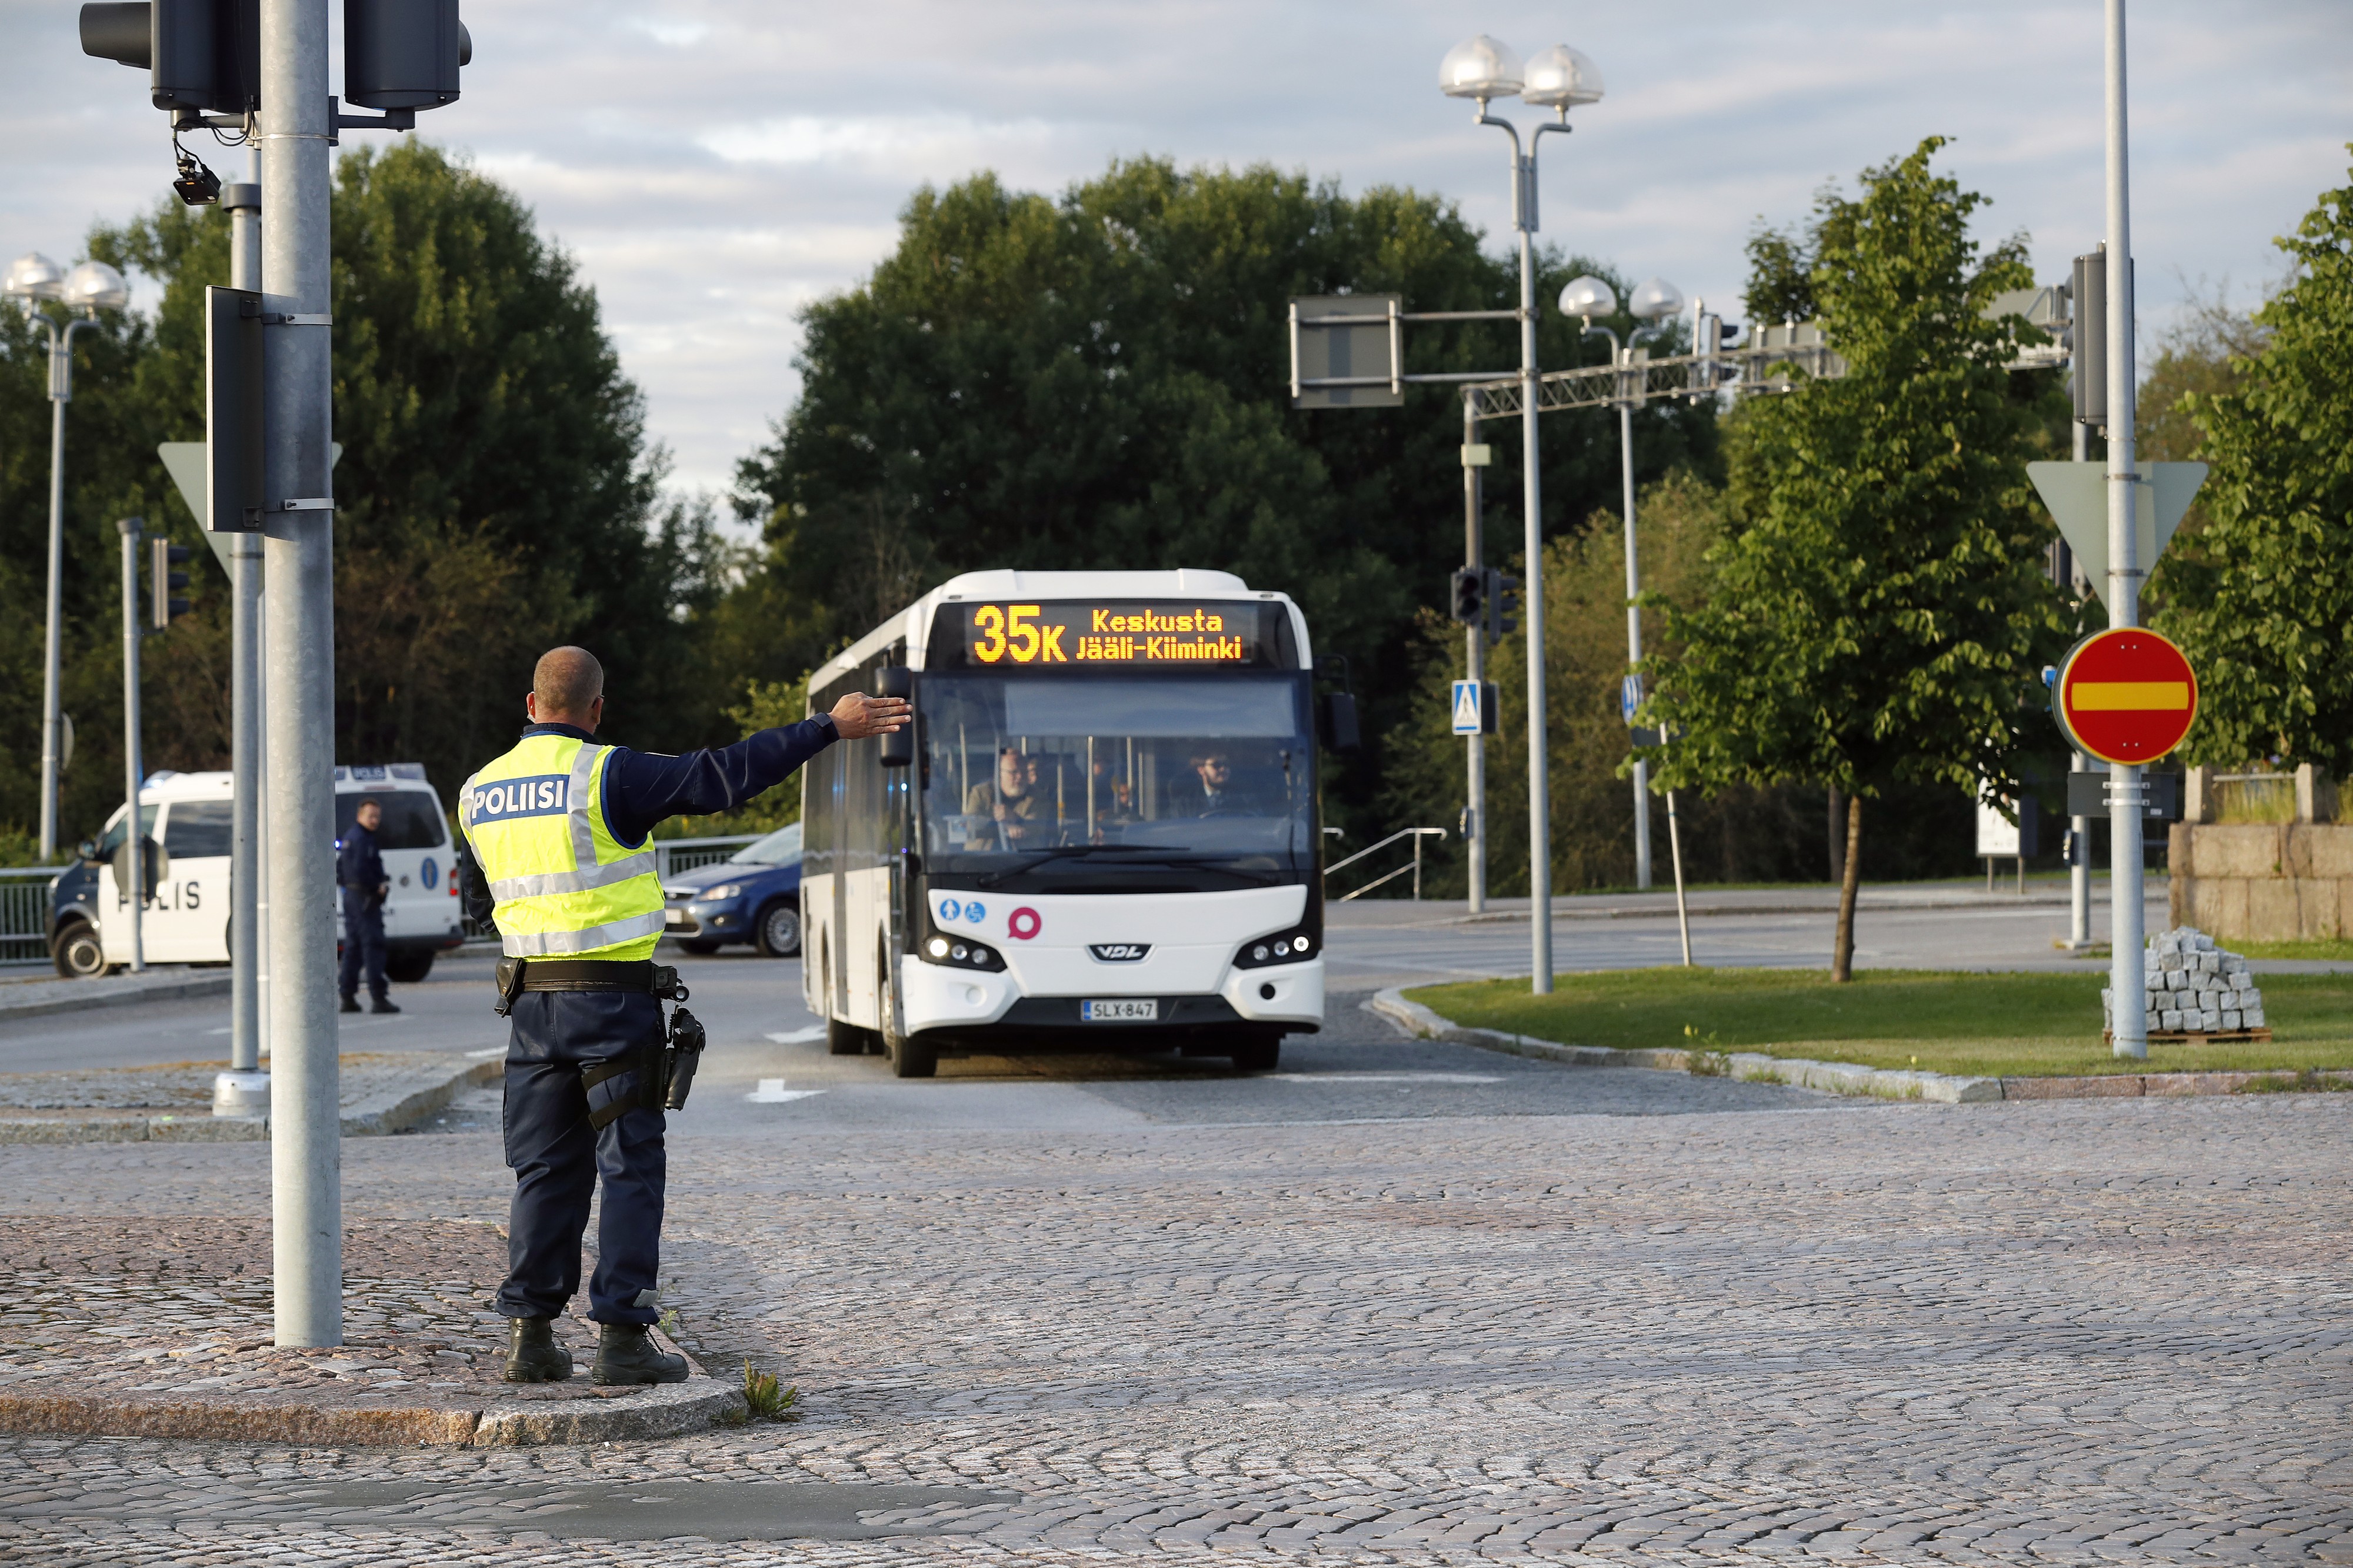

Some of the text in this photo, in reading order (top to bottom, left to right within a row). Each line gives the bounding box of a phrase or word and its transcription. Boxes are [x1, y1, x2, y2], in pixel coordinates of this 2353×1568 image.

[1092, 608, 1223, 632] Keskusta
[974, 605, 1068, 662] 35K
[1076, 636, 1241, 659] Jääli-Kiiminki
[471, 780, 564, 819] POLIISI
[119, 881, 199, 912] PLIS
[1096, 945, 1142, 959] VDL
[1094, 1003, 1152, 1017] SLX-847
